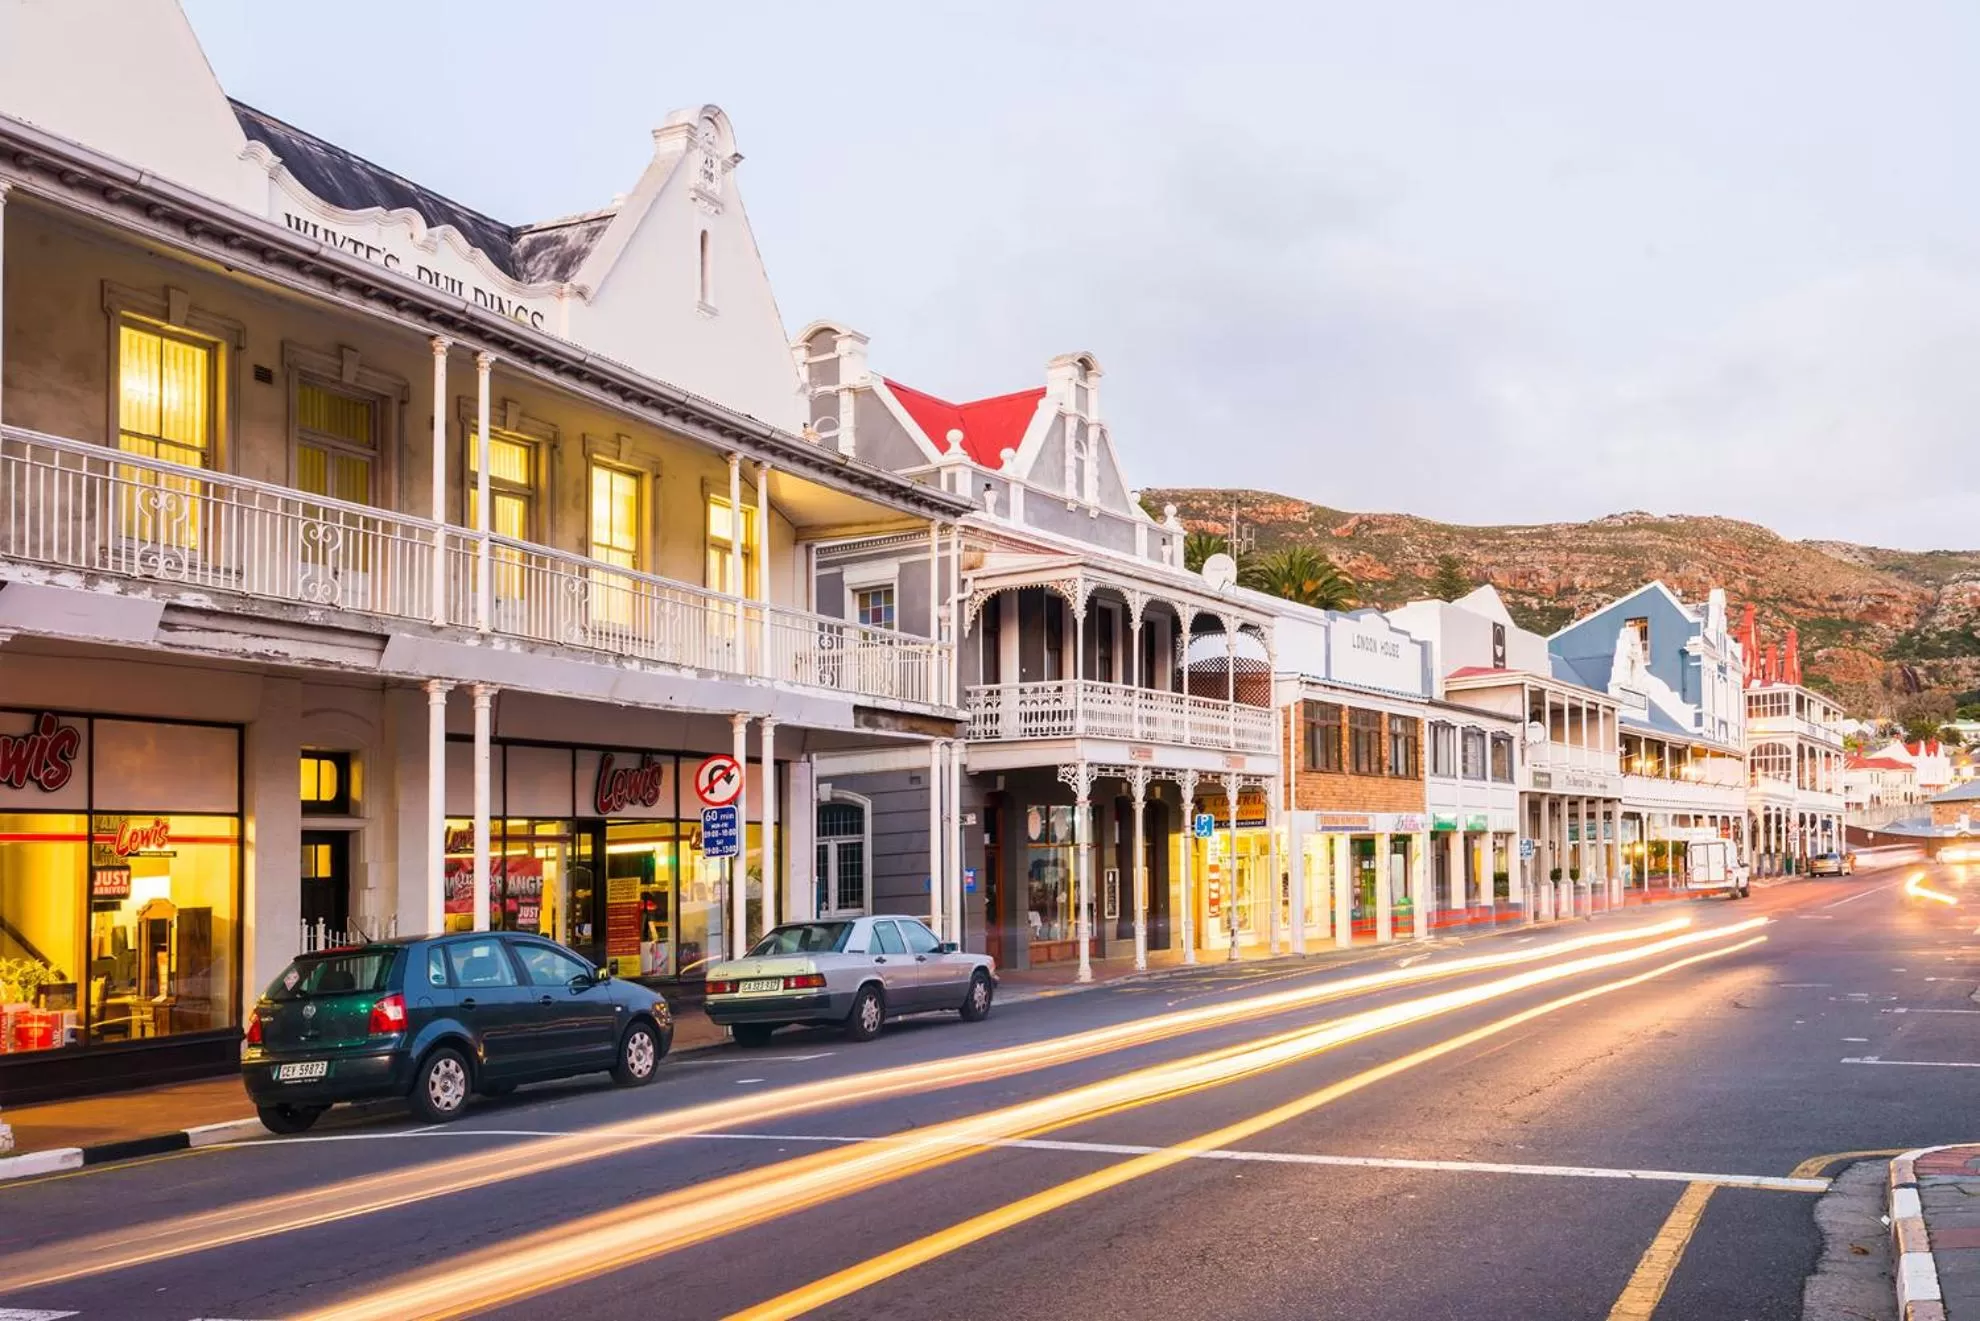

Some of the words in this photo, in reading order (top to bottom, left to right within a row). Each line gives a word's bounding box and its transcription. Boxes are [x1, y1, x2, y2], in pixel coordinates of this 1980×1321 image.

[1352, 633, 1377, 653] LONDON
[1380, 640, 1400, 658] HOUSE
[595, 753, 663, 814] Lewis
[705, 811, 718, 821] 60
[114, 818, 170, 856] Lewis
[94, 870, 130, 886] JUST
[518, 906, 538, 918] JUST
